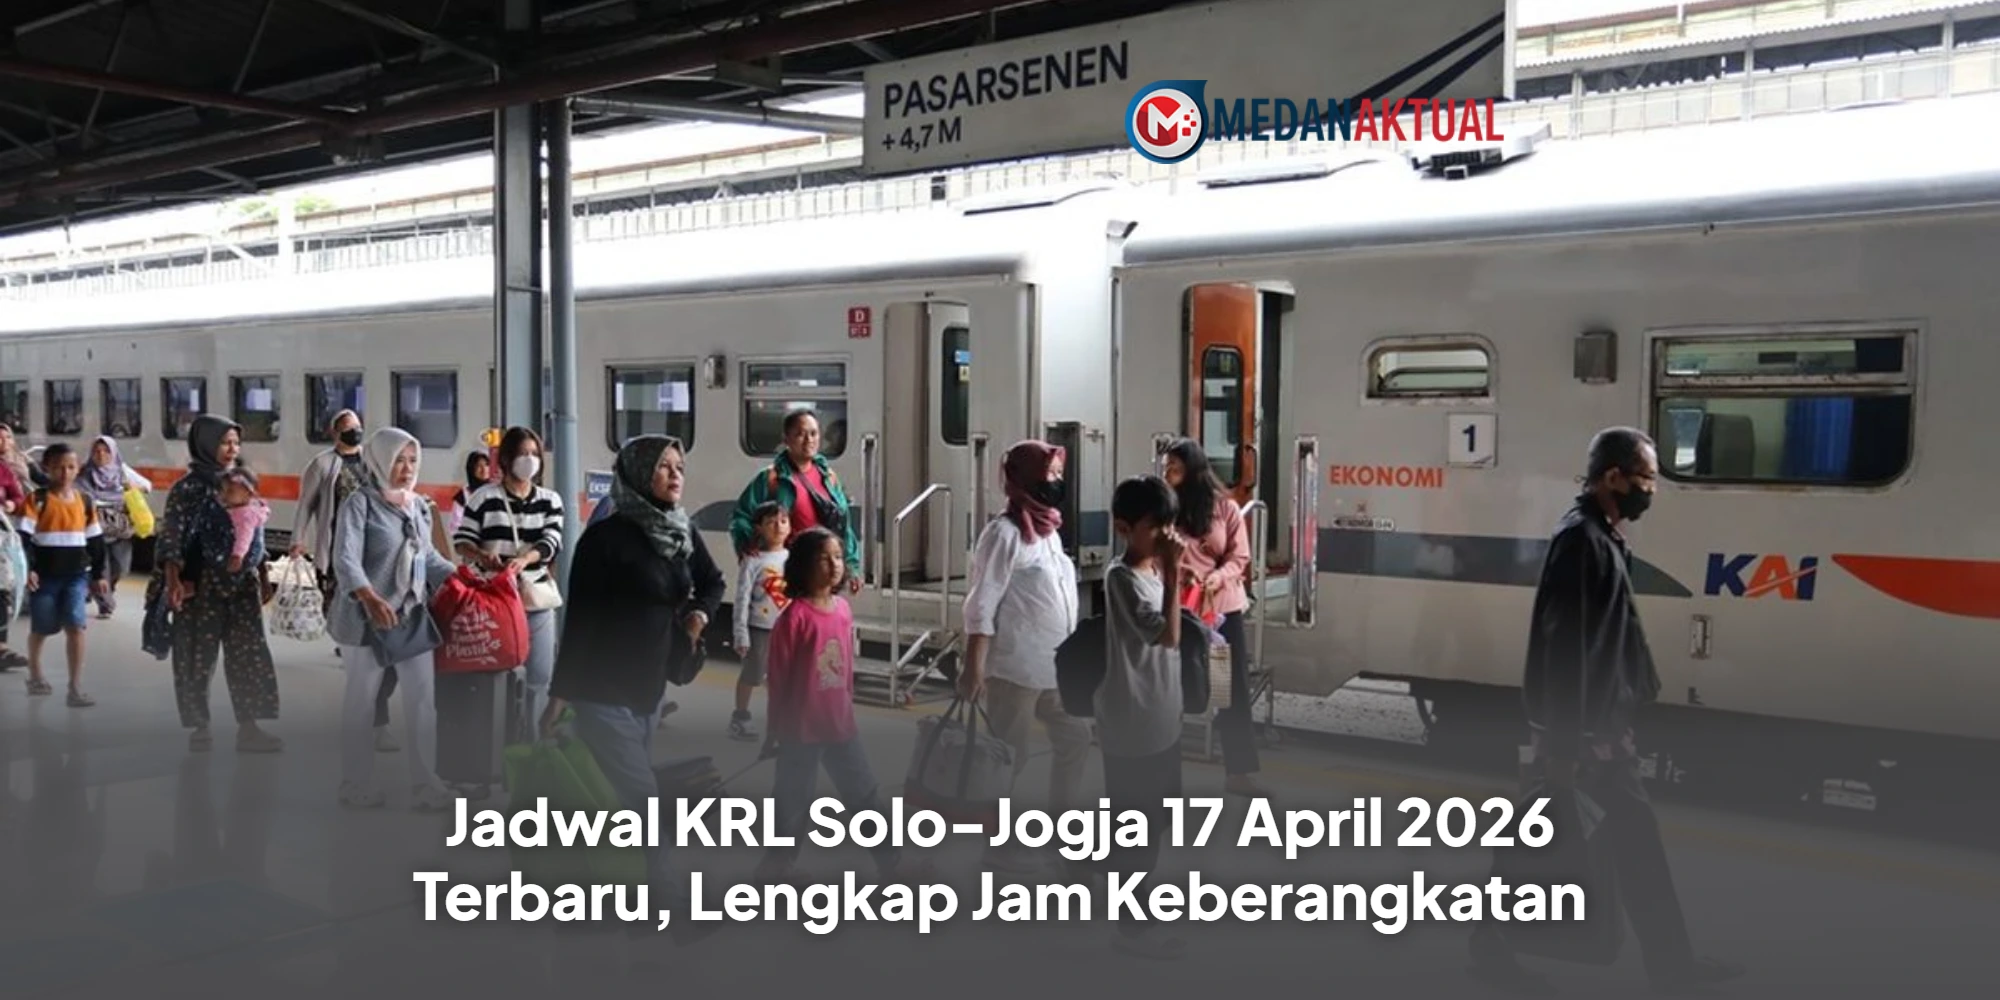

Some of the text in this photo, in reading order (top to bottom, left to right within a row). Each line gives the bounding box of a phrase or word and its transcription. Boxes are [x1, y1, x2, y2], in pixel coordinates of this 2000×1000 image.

[884, 41, 1128, 119] PASARSENEN
[1461, 424, 1477, 453] 1
[1329, 464, 1443, 489] EKONOMI
[1704, 552, 1818, 601] KAI
